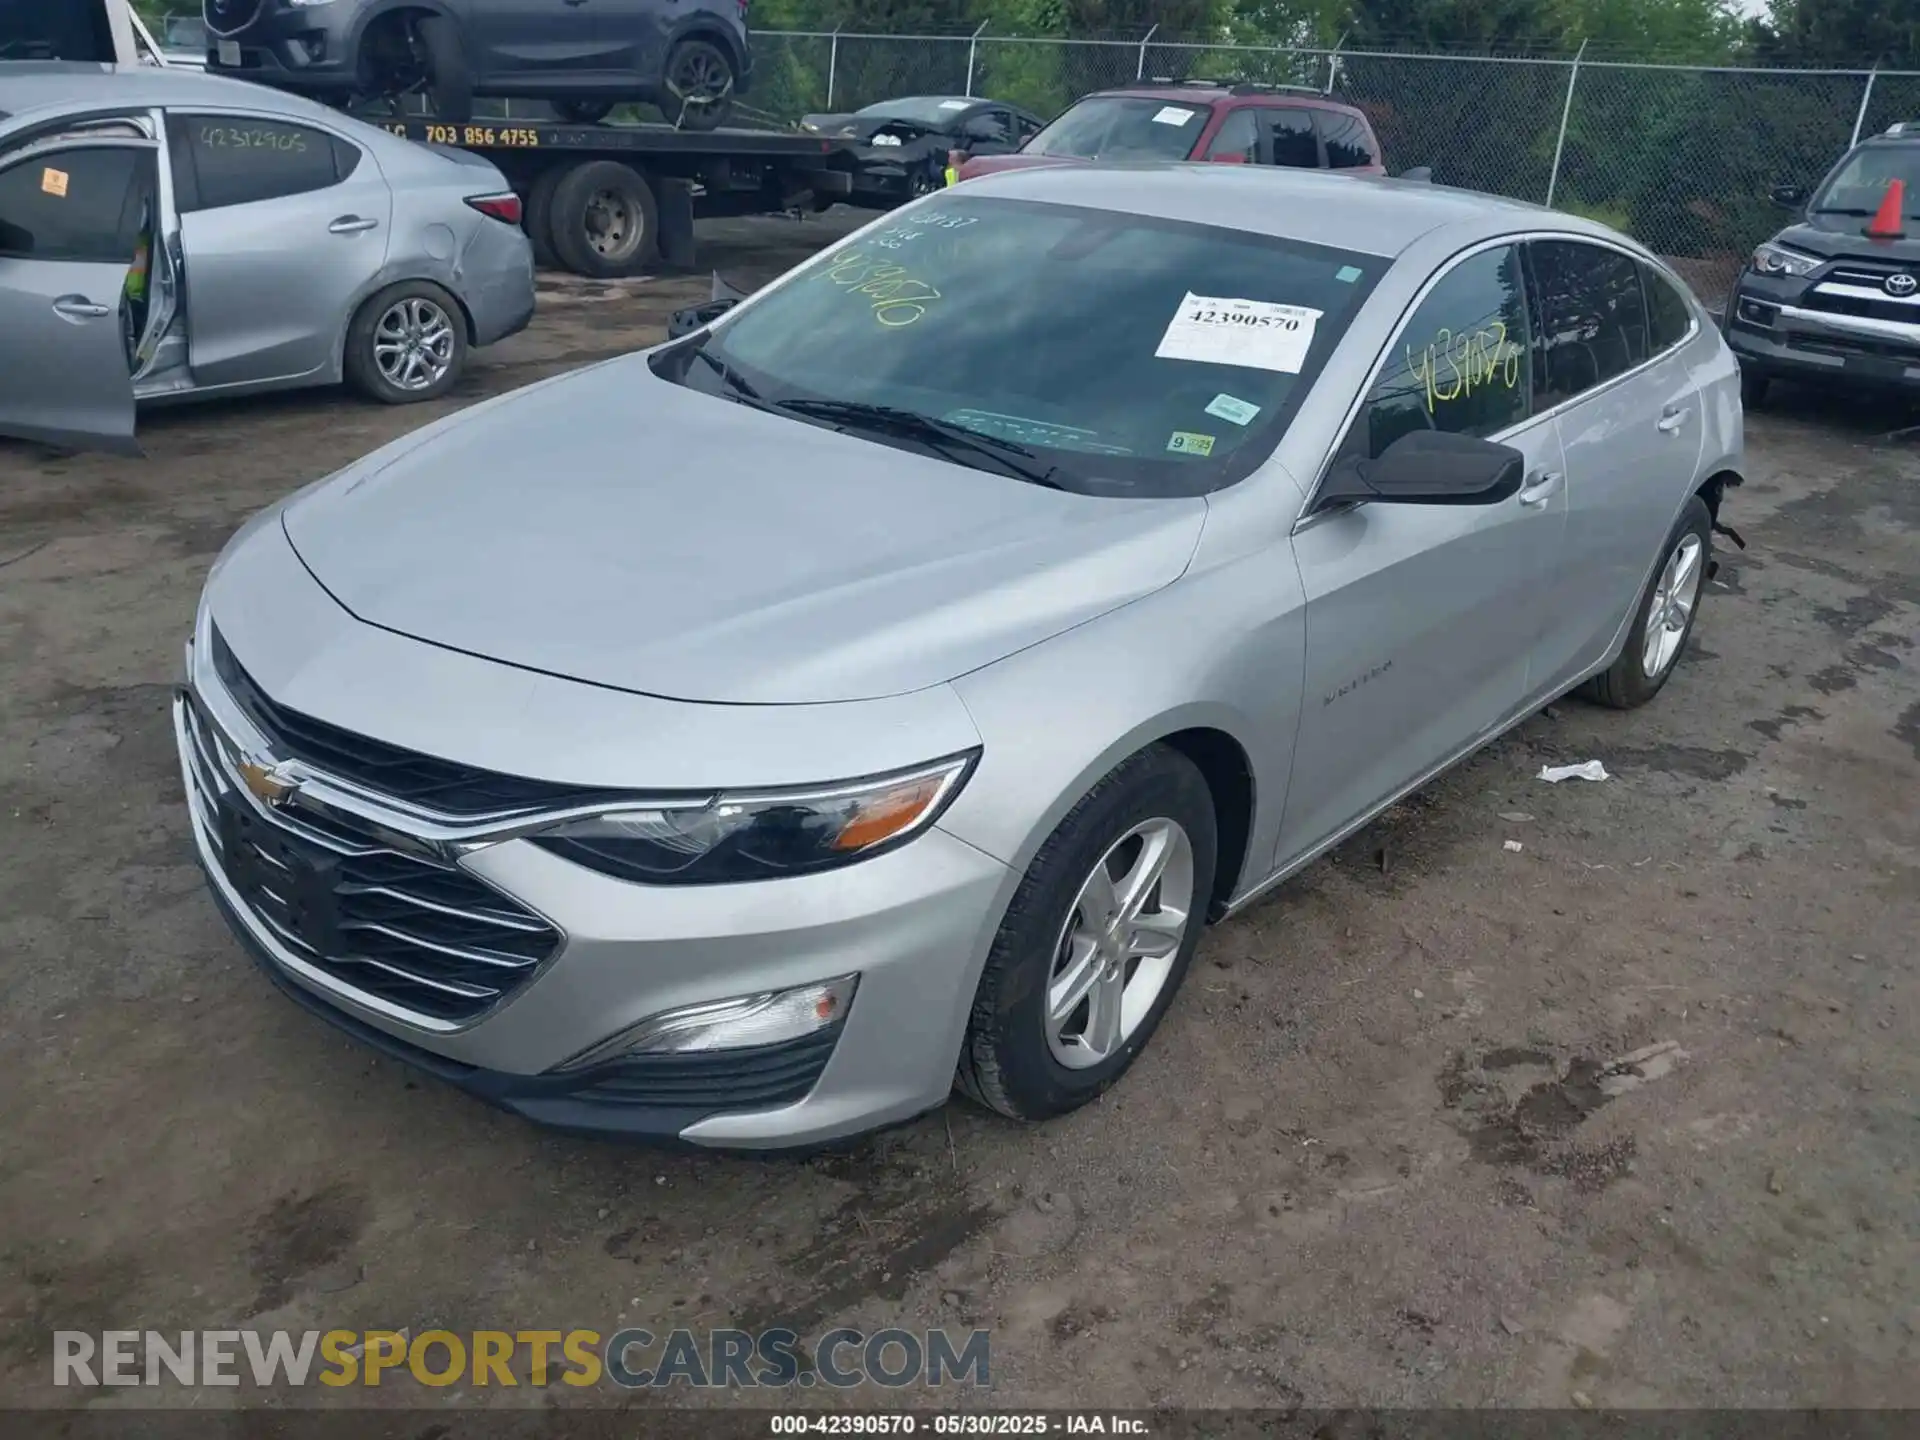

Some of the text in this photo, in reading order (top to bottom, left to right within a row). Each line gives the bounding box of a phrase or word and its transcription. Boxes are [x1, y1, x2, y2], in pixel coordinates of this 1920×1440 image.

[426, 125, 457, 143] 703
[464, 127, 494, 145] 856
[500, 128, 538, 146] 4755
[1189, 310, 1299, 332] 42390570
[1174, 437, 1185, 448] 9
